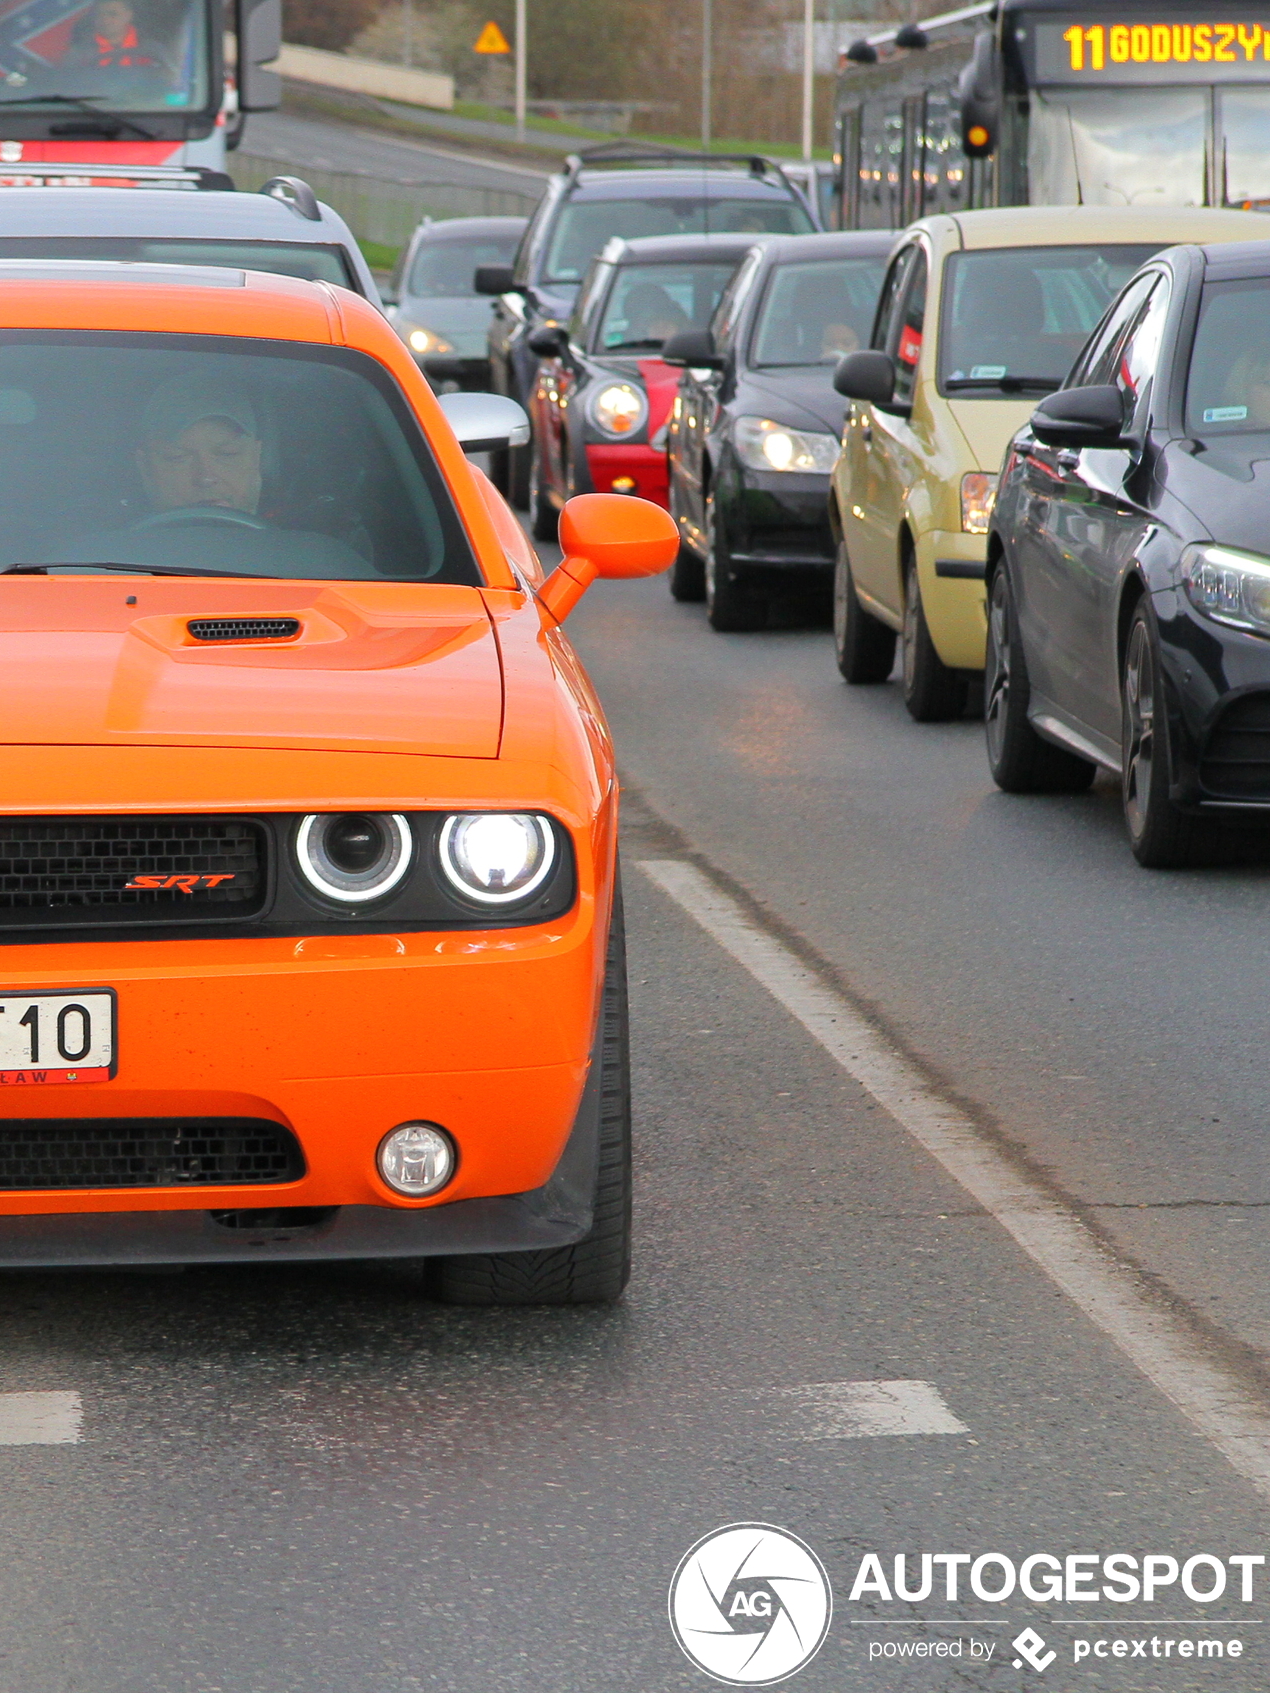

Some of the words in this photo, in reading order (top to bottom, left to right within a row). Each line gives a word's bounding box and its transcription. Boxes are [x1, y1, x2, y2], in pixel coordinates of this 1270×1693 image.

[1063, 24, 1104, 71] 11
[1109, 23, 1270, 63] GODUSZY
[124, 874, 235, 894] SRT
